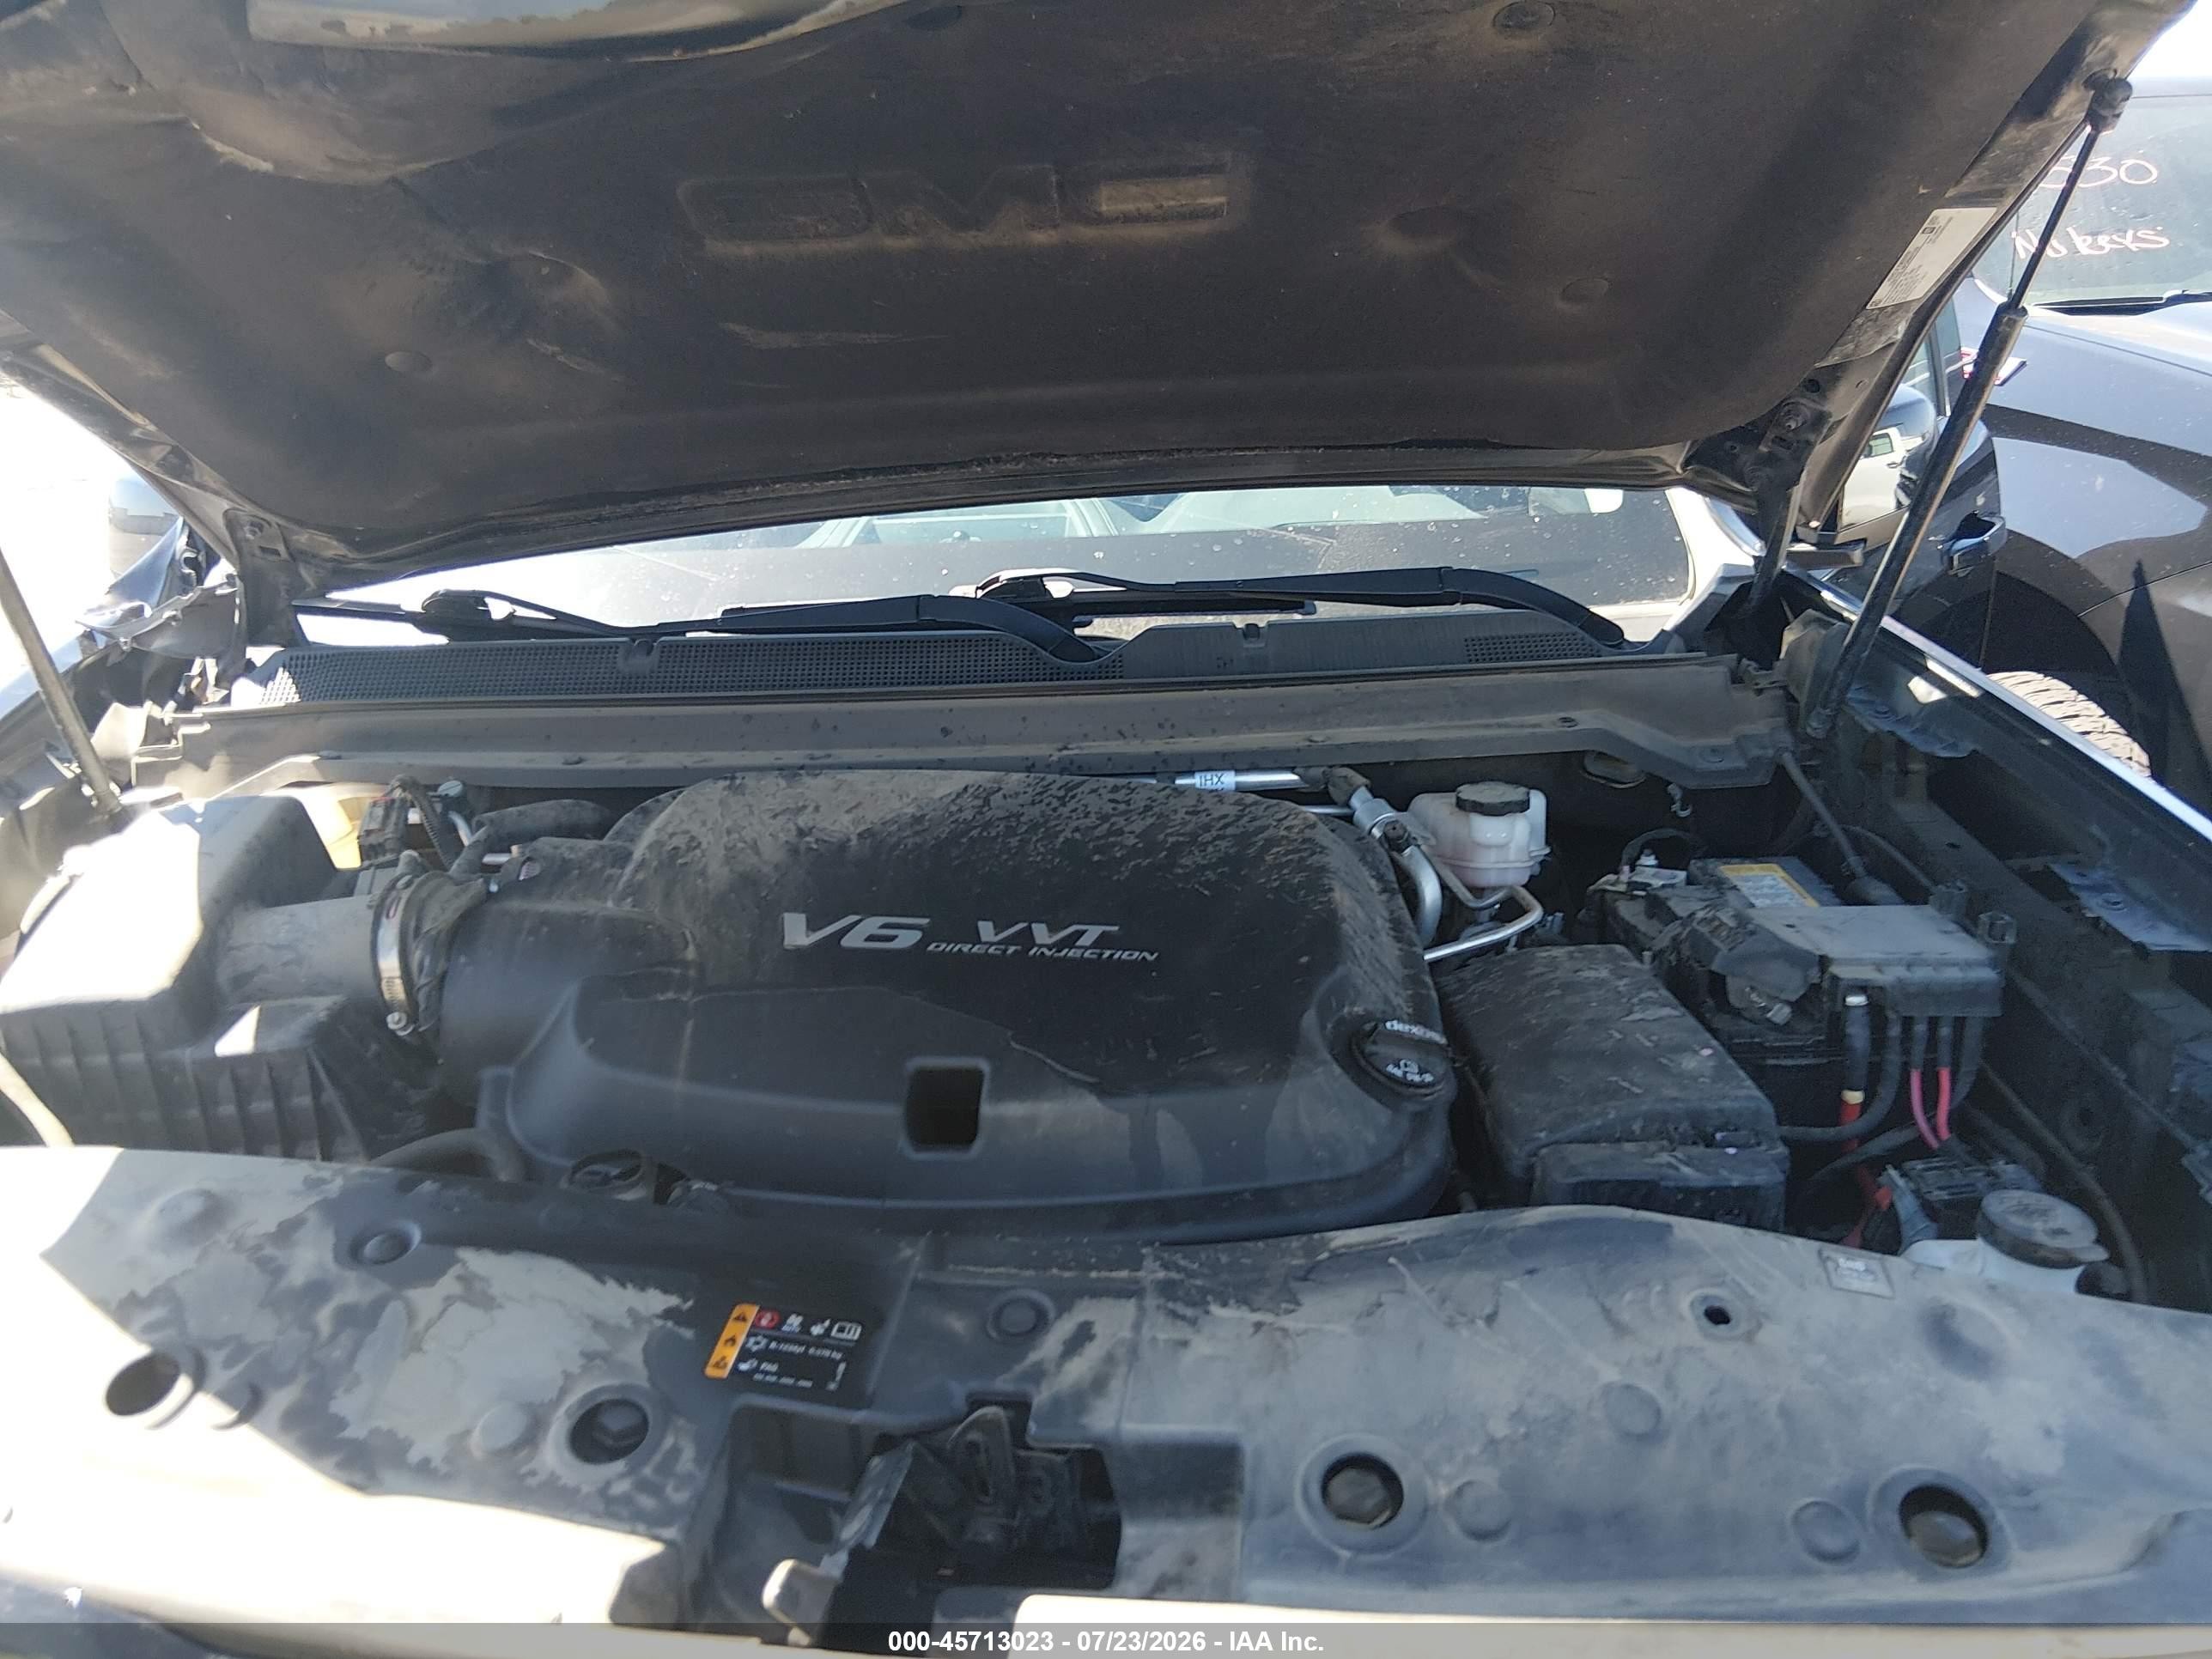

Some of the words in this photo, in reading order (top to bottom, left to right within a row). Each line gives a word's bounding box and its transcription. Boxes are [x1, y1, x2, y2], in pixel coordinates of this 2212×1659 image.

[783, 912, 930, 950] V6
[977, 920, 1119, 947] VVT
[927, 942, 1022, 955] DIRECT
[1028, 945, 1159, 962] INJECTION
